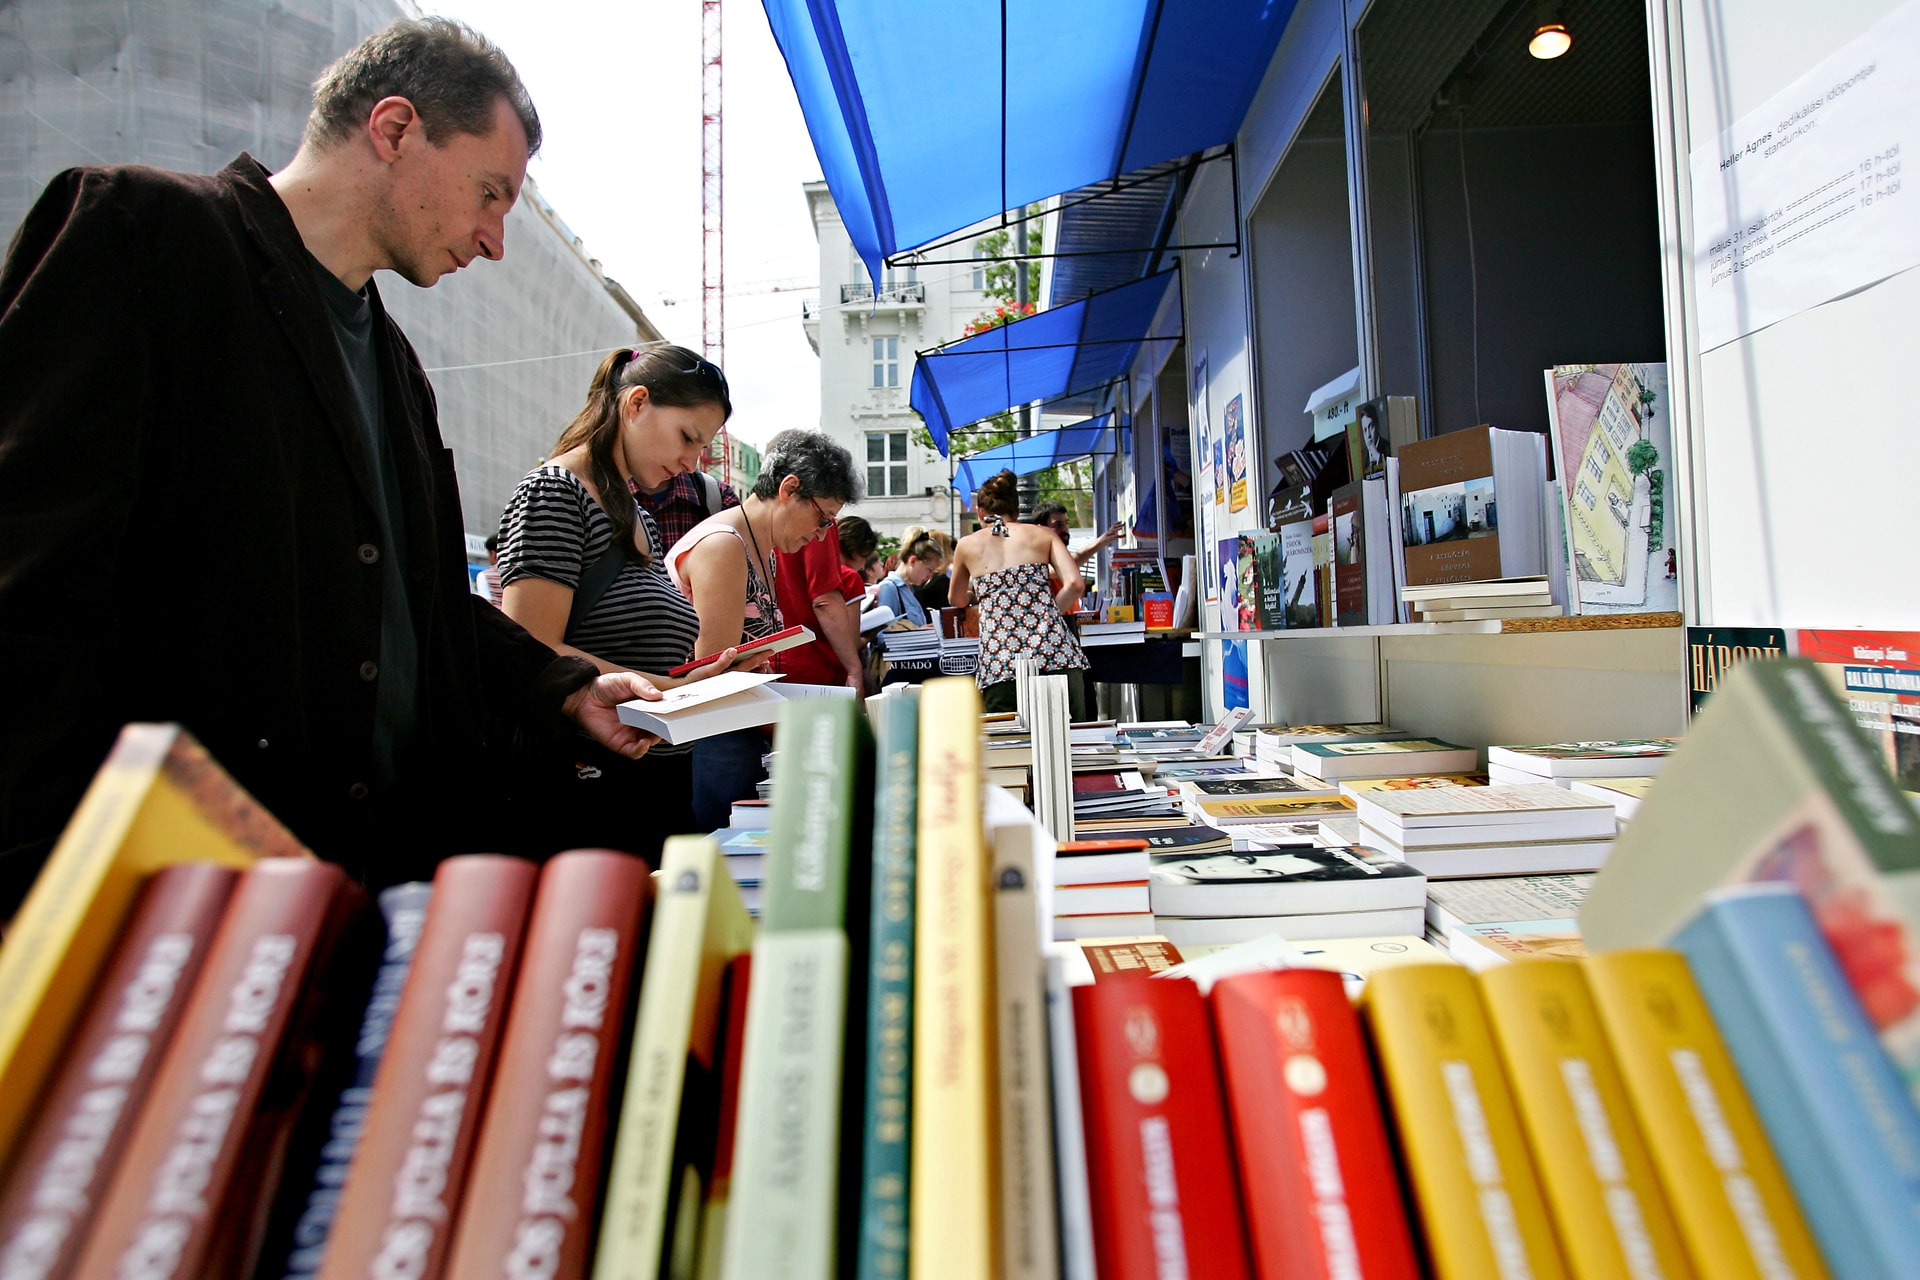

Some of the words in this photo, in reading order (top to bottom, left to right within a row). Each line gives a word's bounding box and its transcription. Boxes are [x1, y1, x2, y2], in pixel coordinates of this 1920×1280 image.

[1719, 151, 1743, 172] Heller
[1745, 131, 1772, 156] Ágnes
[1777, 98, 1823, 133] dedikálási
[1709, 236, 1732, 256] május
[1733, 231, 1746, 244] 31.
[1859, 159, 1872, 174] 16
[1710, 251, 1732, 273] június
[1742, 231, 1769, 254] péntek
[1860, 177, 1872, 191] 17
[1711, 266, 1732, 287] június
[1733, 262, 1740, 273] 2
[1741, 244, 1775, 270] szombat
[900, 659, 932, 670] KIADÓ
[1475, 927, 1534, 953] Heine
